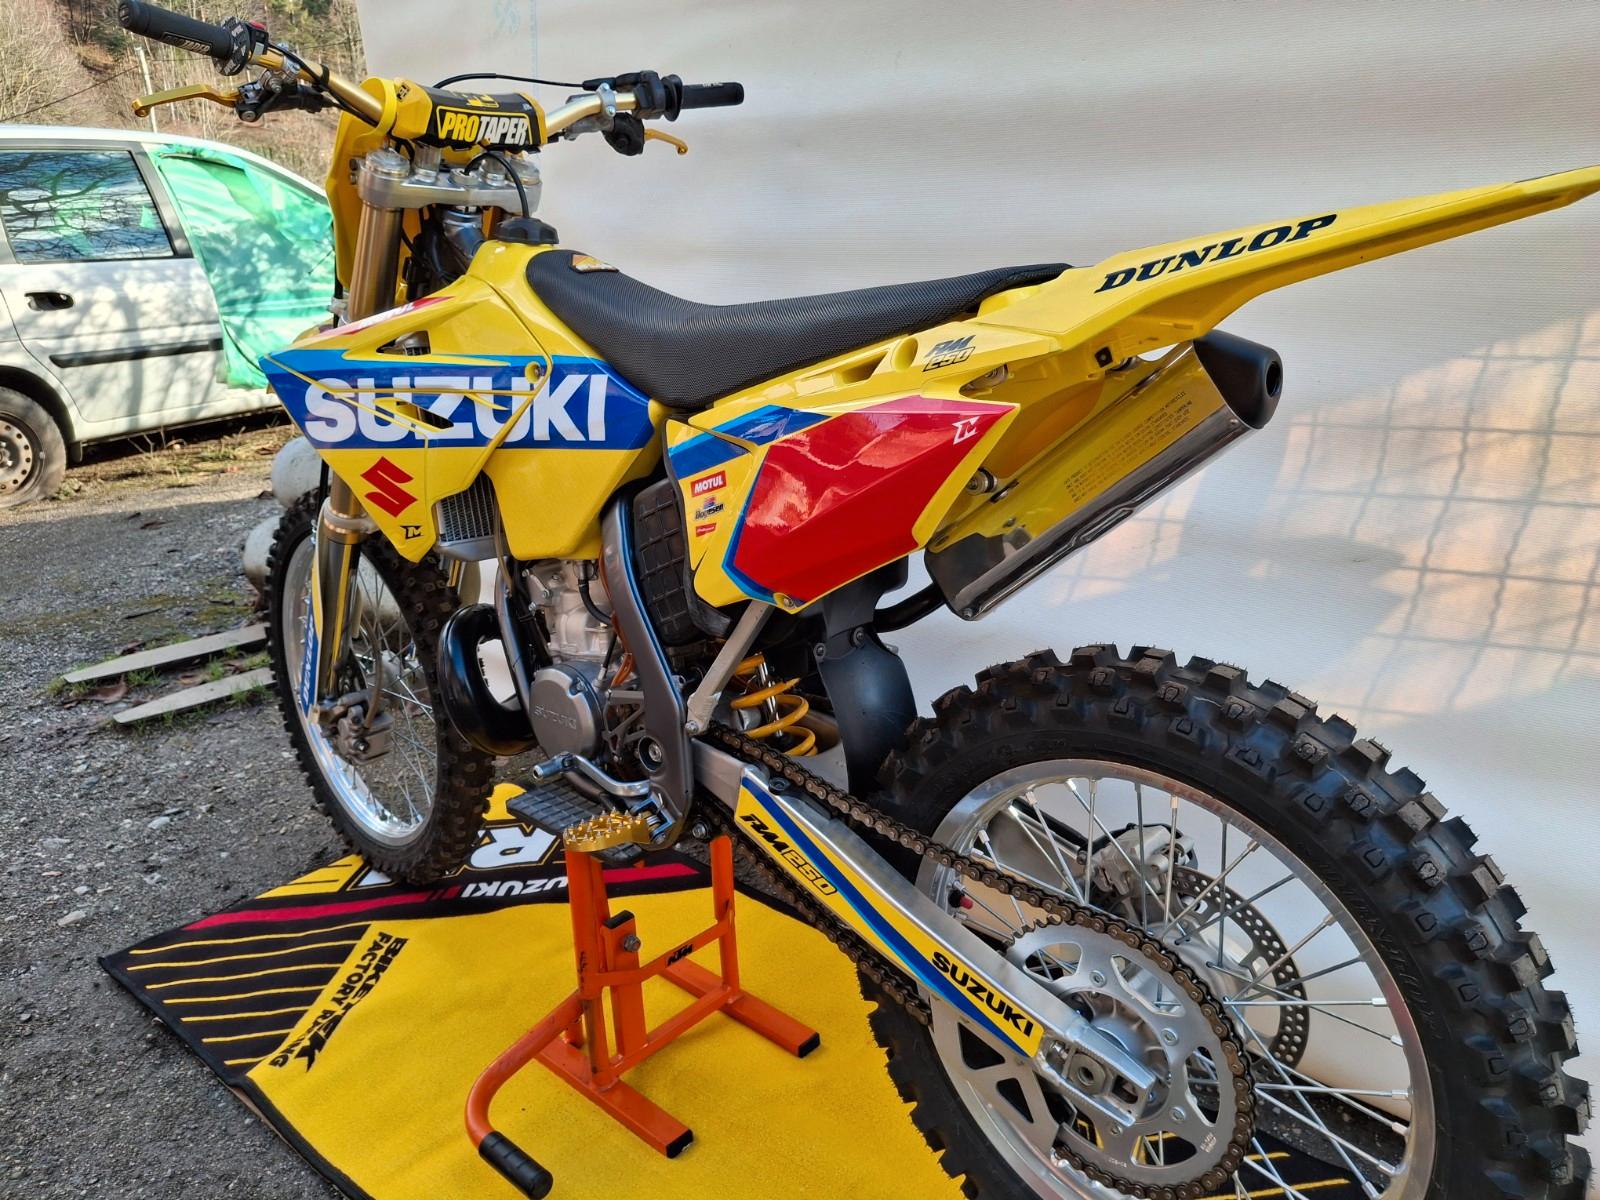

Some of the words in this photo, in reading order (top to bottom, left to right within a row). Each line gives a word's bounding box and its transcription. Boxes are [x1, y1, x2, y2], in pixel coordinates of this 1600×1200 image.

[1093, 213, 1338, 294] DUNLOP
[304, 373, 609, 443] SUZUKI
[694, 475, 724, 494] MOTUL
[461, 876, 569, 898] UZUKI
[331, 931, 393, 1007] FACTORY
[931, 951, 1034, 1038] SUZUKI
